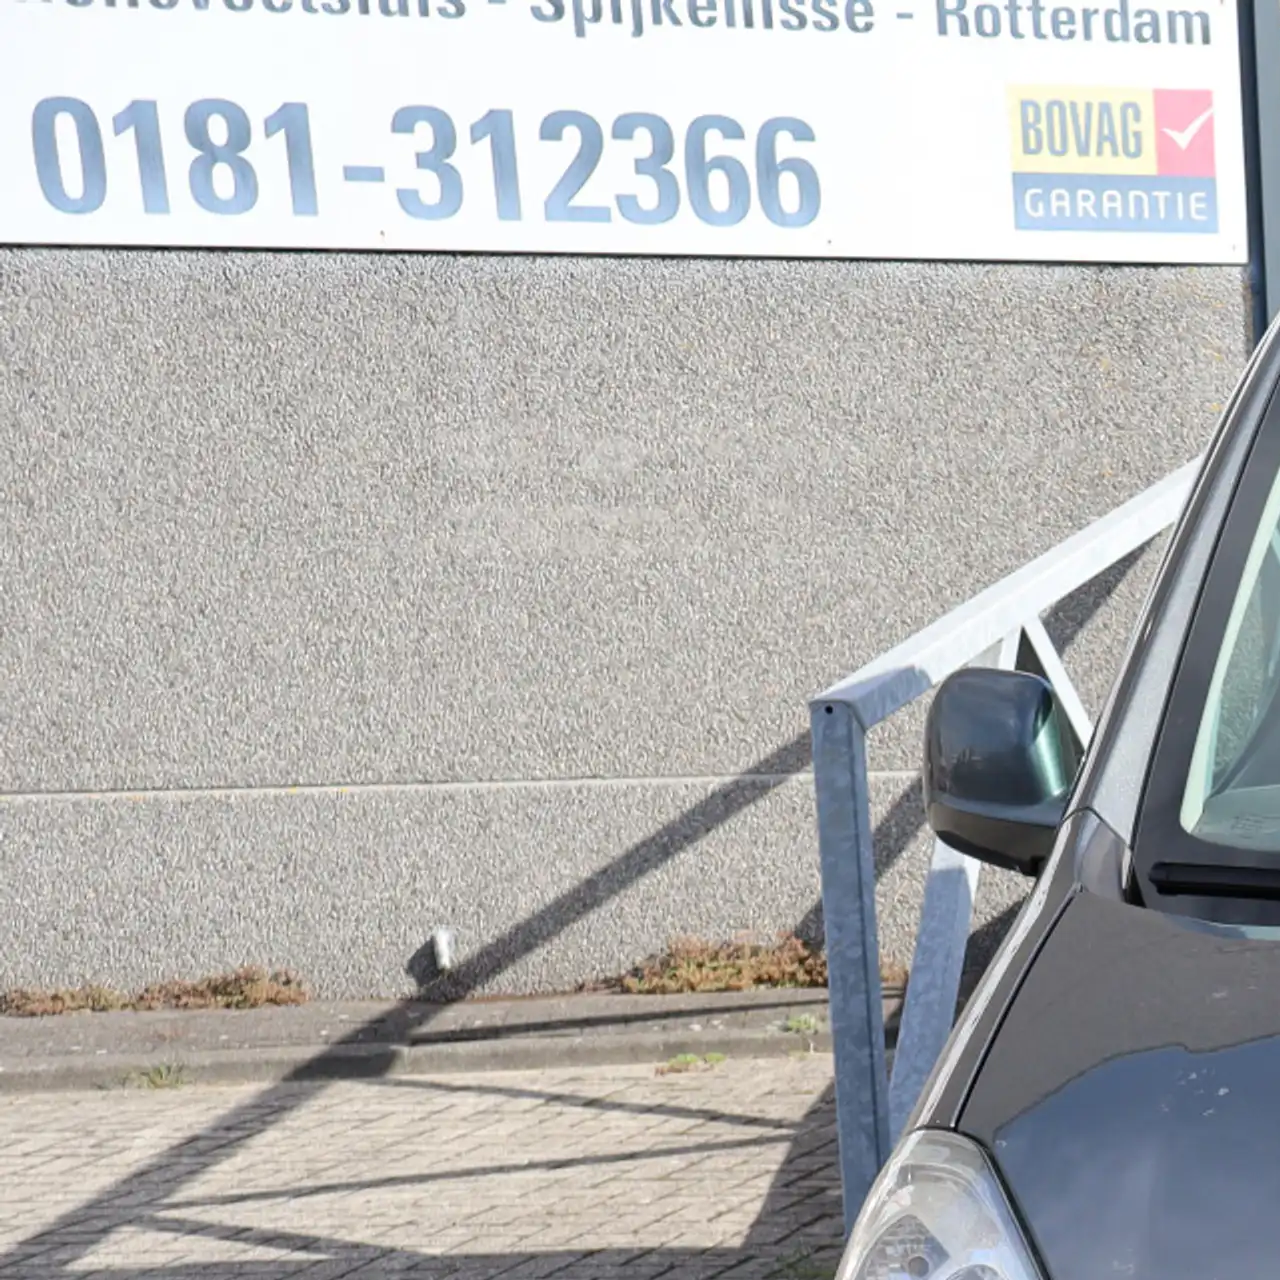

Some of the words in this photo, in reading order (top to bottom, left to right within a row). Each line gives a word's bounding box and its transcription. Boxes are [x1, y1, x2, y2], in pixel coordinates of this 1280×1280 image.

[936, 0, 1211, 45] Rotterdam
[1020, 100, 1142, 159] BOVAG
[31, 96, 821, 228] 0181-312366
[1024, 188, 1207, 221] GARANTIE
